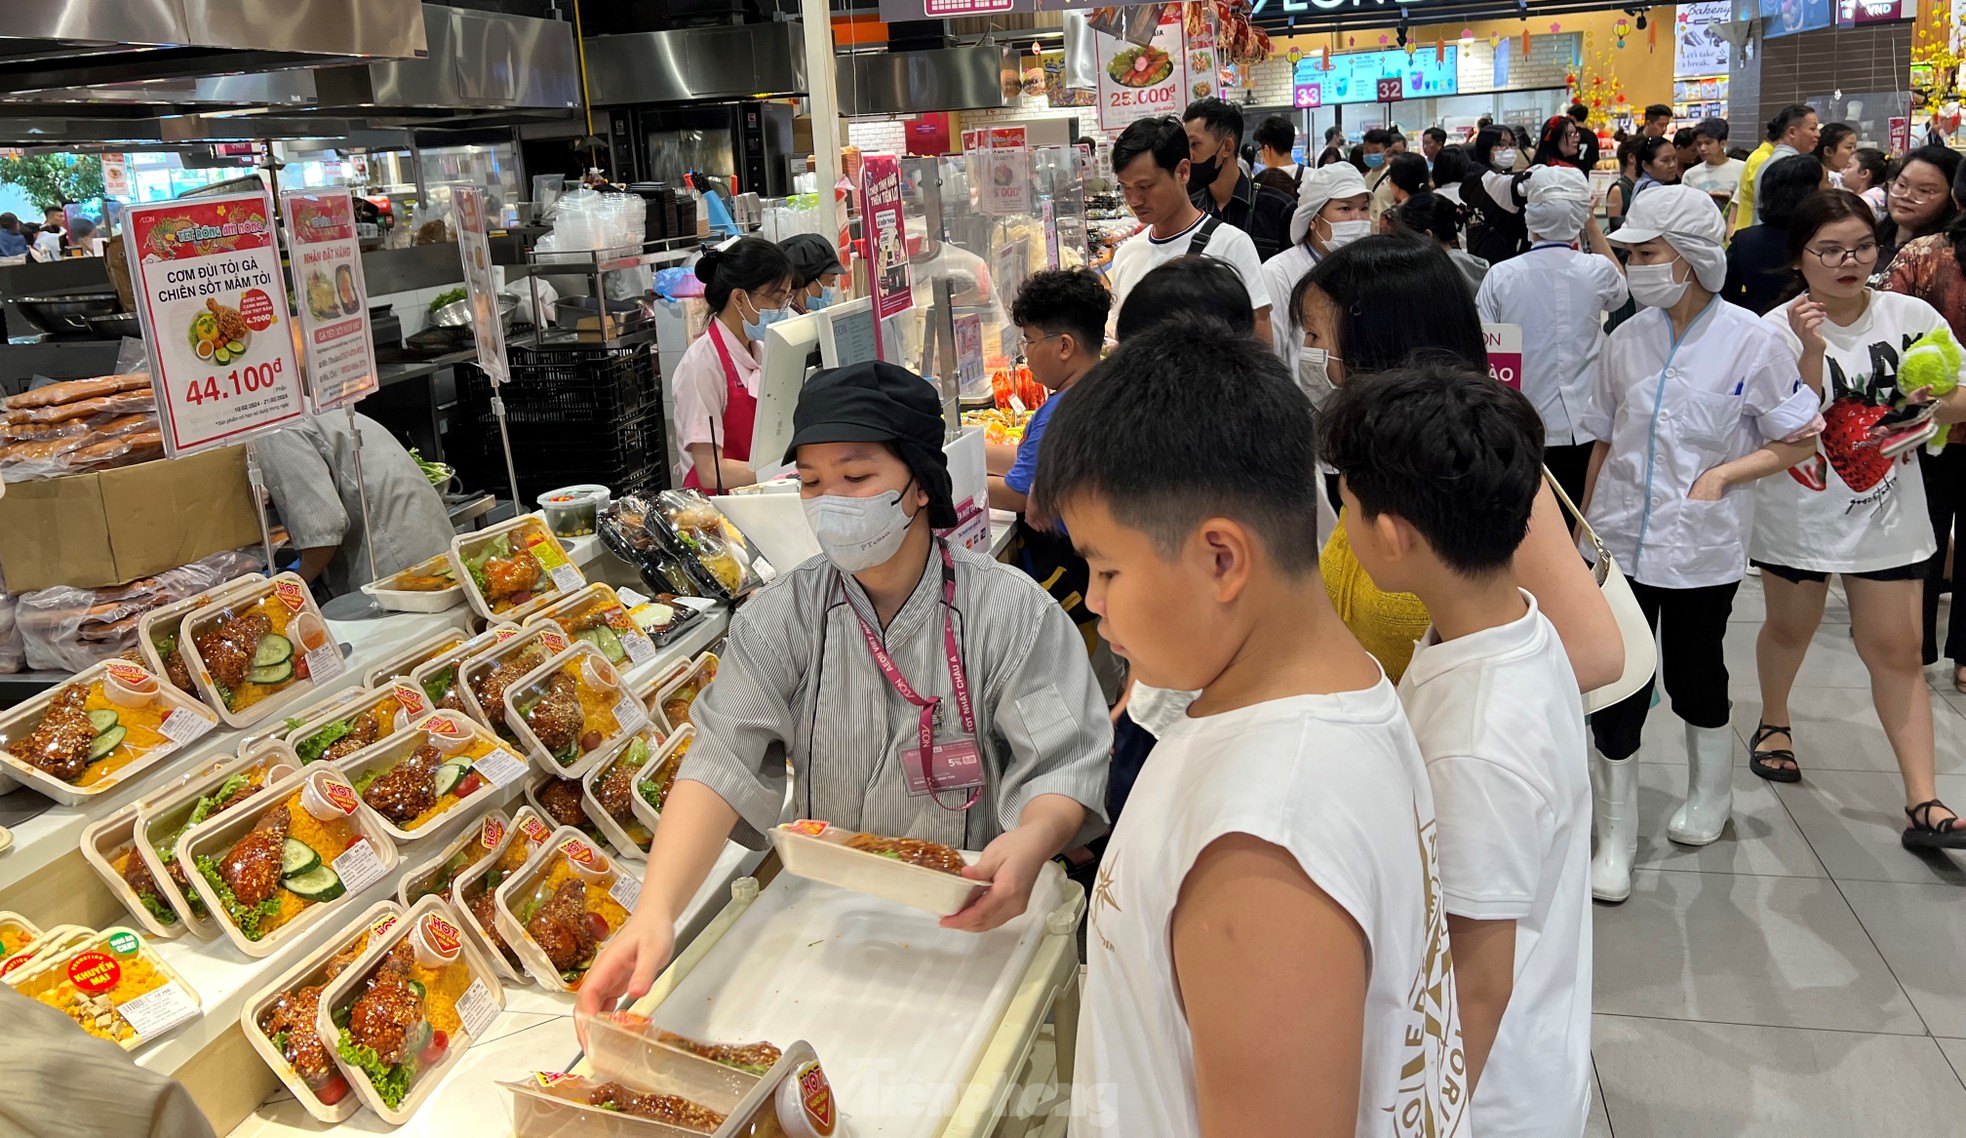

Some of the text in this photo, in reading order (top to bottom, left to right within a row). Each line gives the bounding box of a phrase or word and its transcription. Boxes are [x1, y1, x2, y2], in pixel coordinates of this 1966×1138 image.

[1866, 4, 1892, 17] VND
[1699, 50, 1715, 58] take
[1297, 88, 1320, 105] 33
[1379, 82, 1402, 99] 32
[1579, 144, 1587, 160] 7
[167, 269, 195, 284] CƠM
[198, 263, 218, 279] ĐÙI
[242, 255, 258, 271] GÀ
[158, 283, 197, 303] CHIÊN
[198, 277, 222, 296] SỐT
[224, 274, 251, 291] MẮM
[186, 357, 283, 406] 44.100đ
[278, 582, 299, 594] HOT
[543, 633, 565, 646] HOT
[110, 662, 141, 674] HOT
[877, 653, 894, 673] AEON
[397, 688, 421, 703] HOT
[329, 783, 354, 799] HOT
[485, 821, 497, 846] HOT
[525, 818, 541, 835] HOT
[564, 841, 583, 855] HOT
[433, 916, 458, 940] HOT
[73, 961, 115, 983] KHUYẾN
[89, 972, 111, 986] MẠI
[802, 1068, 821, 1095] HOT
